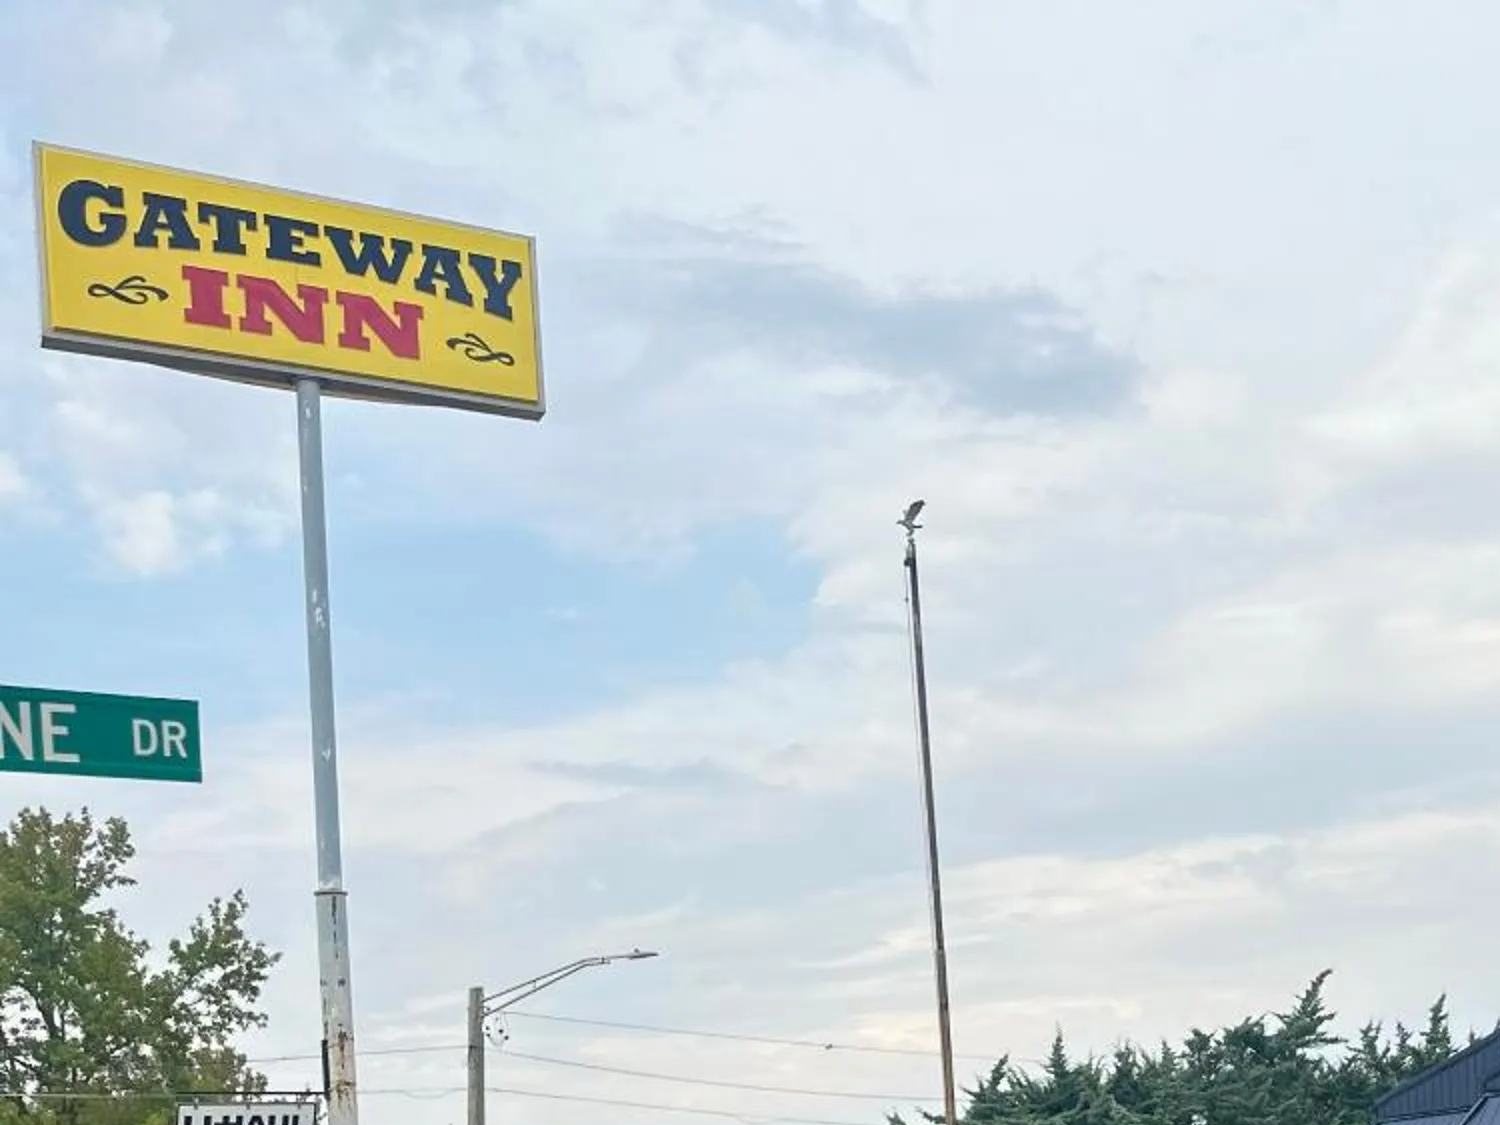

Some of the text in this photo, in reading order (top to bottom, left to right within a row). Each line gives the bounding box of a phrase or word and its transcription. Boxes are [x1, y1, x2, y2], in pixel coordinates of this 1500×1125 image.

[58, 180, 522, 321] GATEWAY
[181, 265, 424, 360] INN
[132, 718, 188, 758] DR
